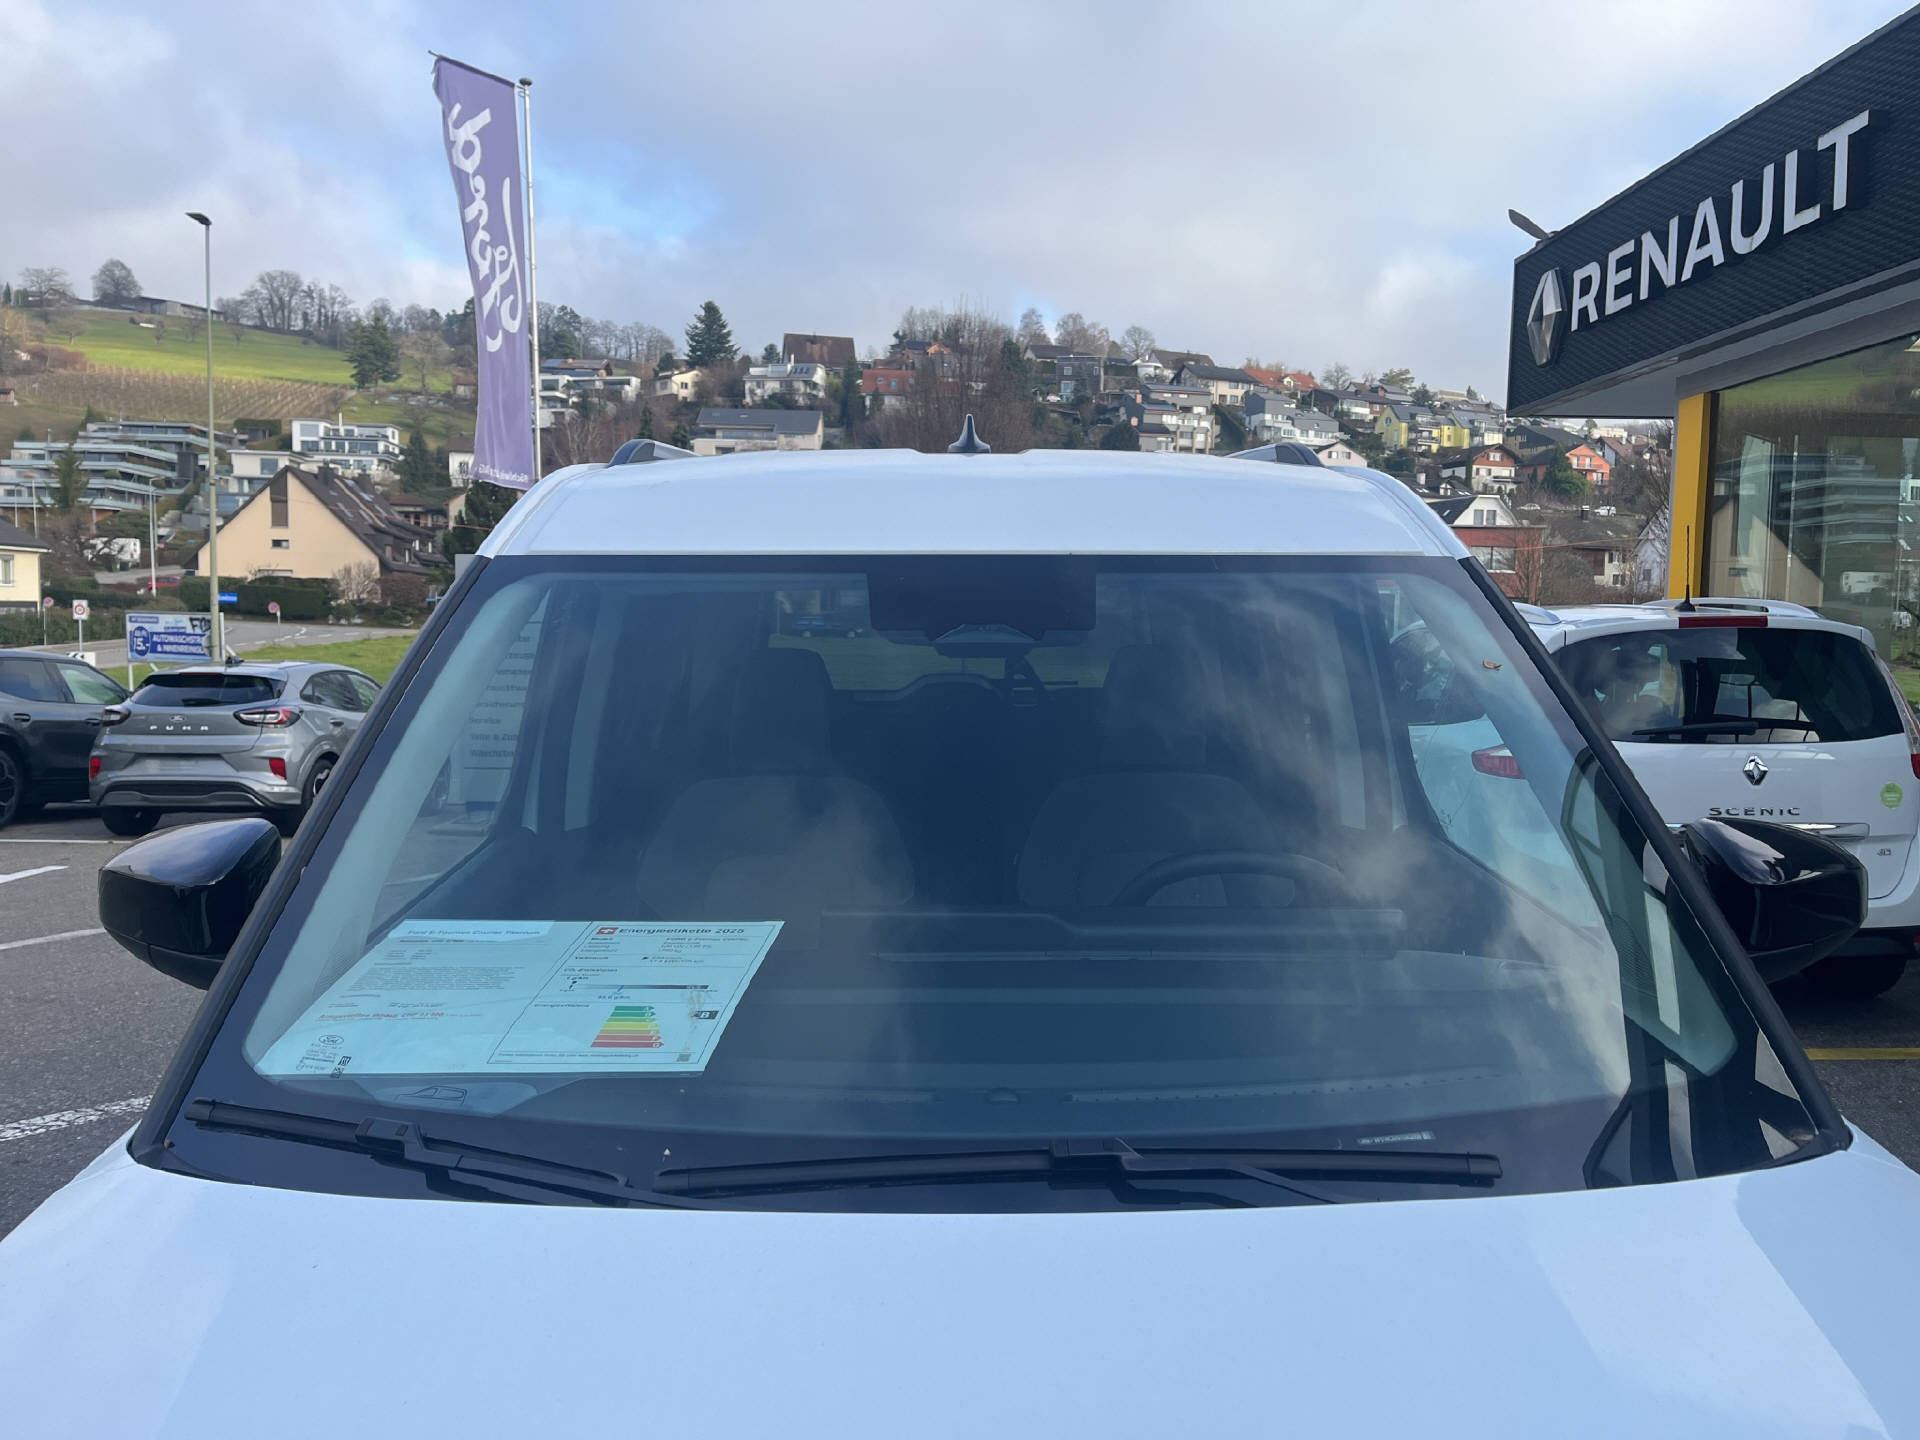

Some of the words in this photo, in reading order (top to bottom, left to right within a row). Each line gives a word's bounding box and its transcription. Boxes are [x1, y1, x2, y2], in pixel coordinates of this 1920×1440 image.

[1571, 109, 1869, 332] RENAULT
[1709, 807, 1800, 816] SCENIC
[700, 1011, 710, 1019] B
